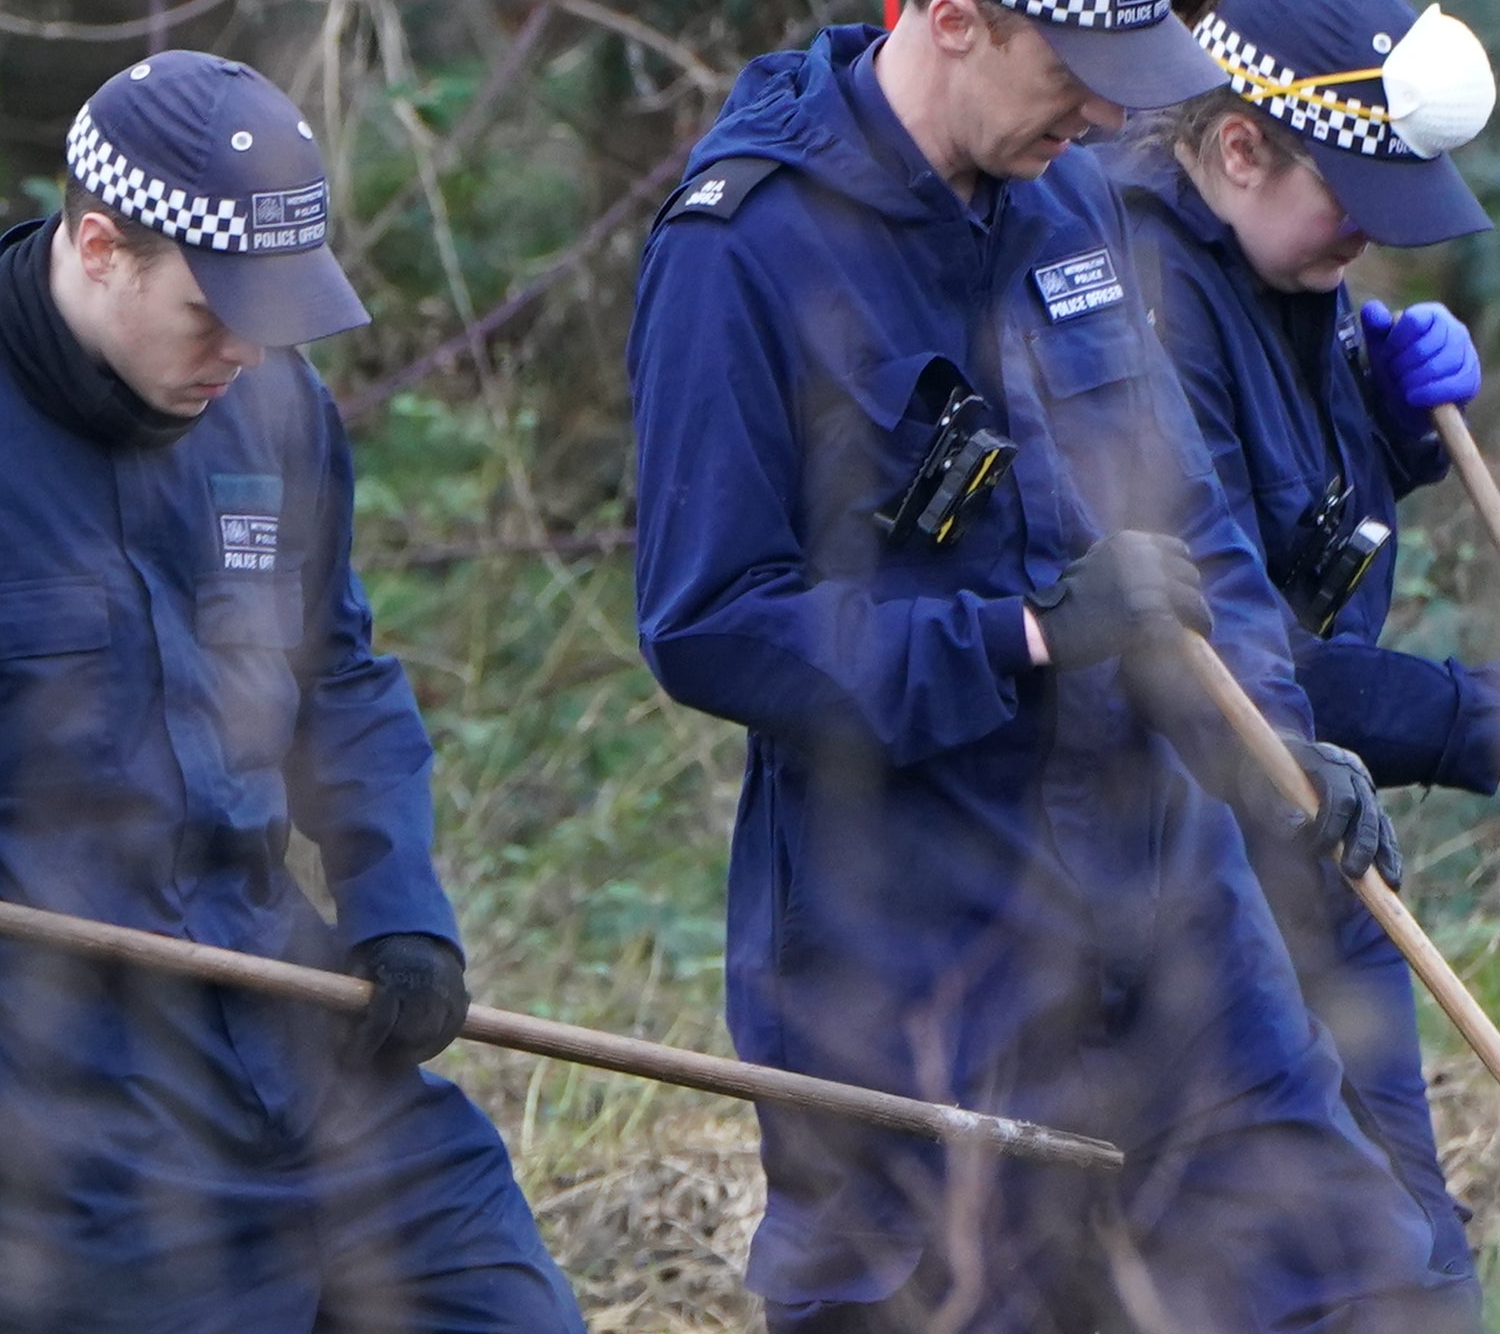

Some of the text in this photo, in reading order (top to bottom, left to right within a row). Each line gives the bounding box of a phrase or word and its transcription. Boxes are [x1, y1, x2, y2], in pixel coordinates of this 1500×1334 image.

[1116, 3, 1153, 26] POLICE
[254, 229, 297, 249] POLICE
[1049, 284, 1124, 320] POLICE OFFICER
